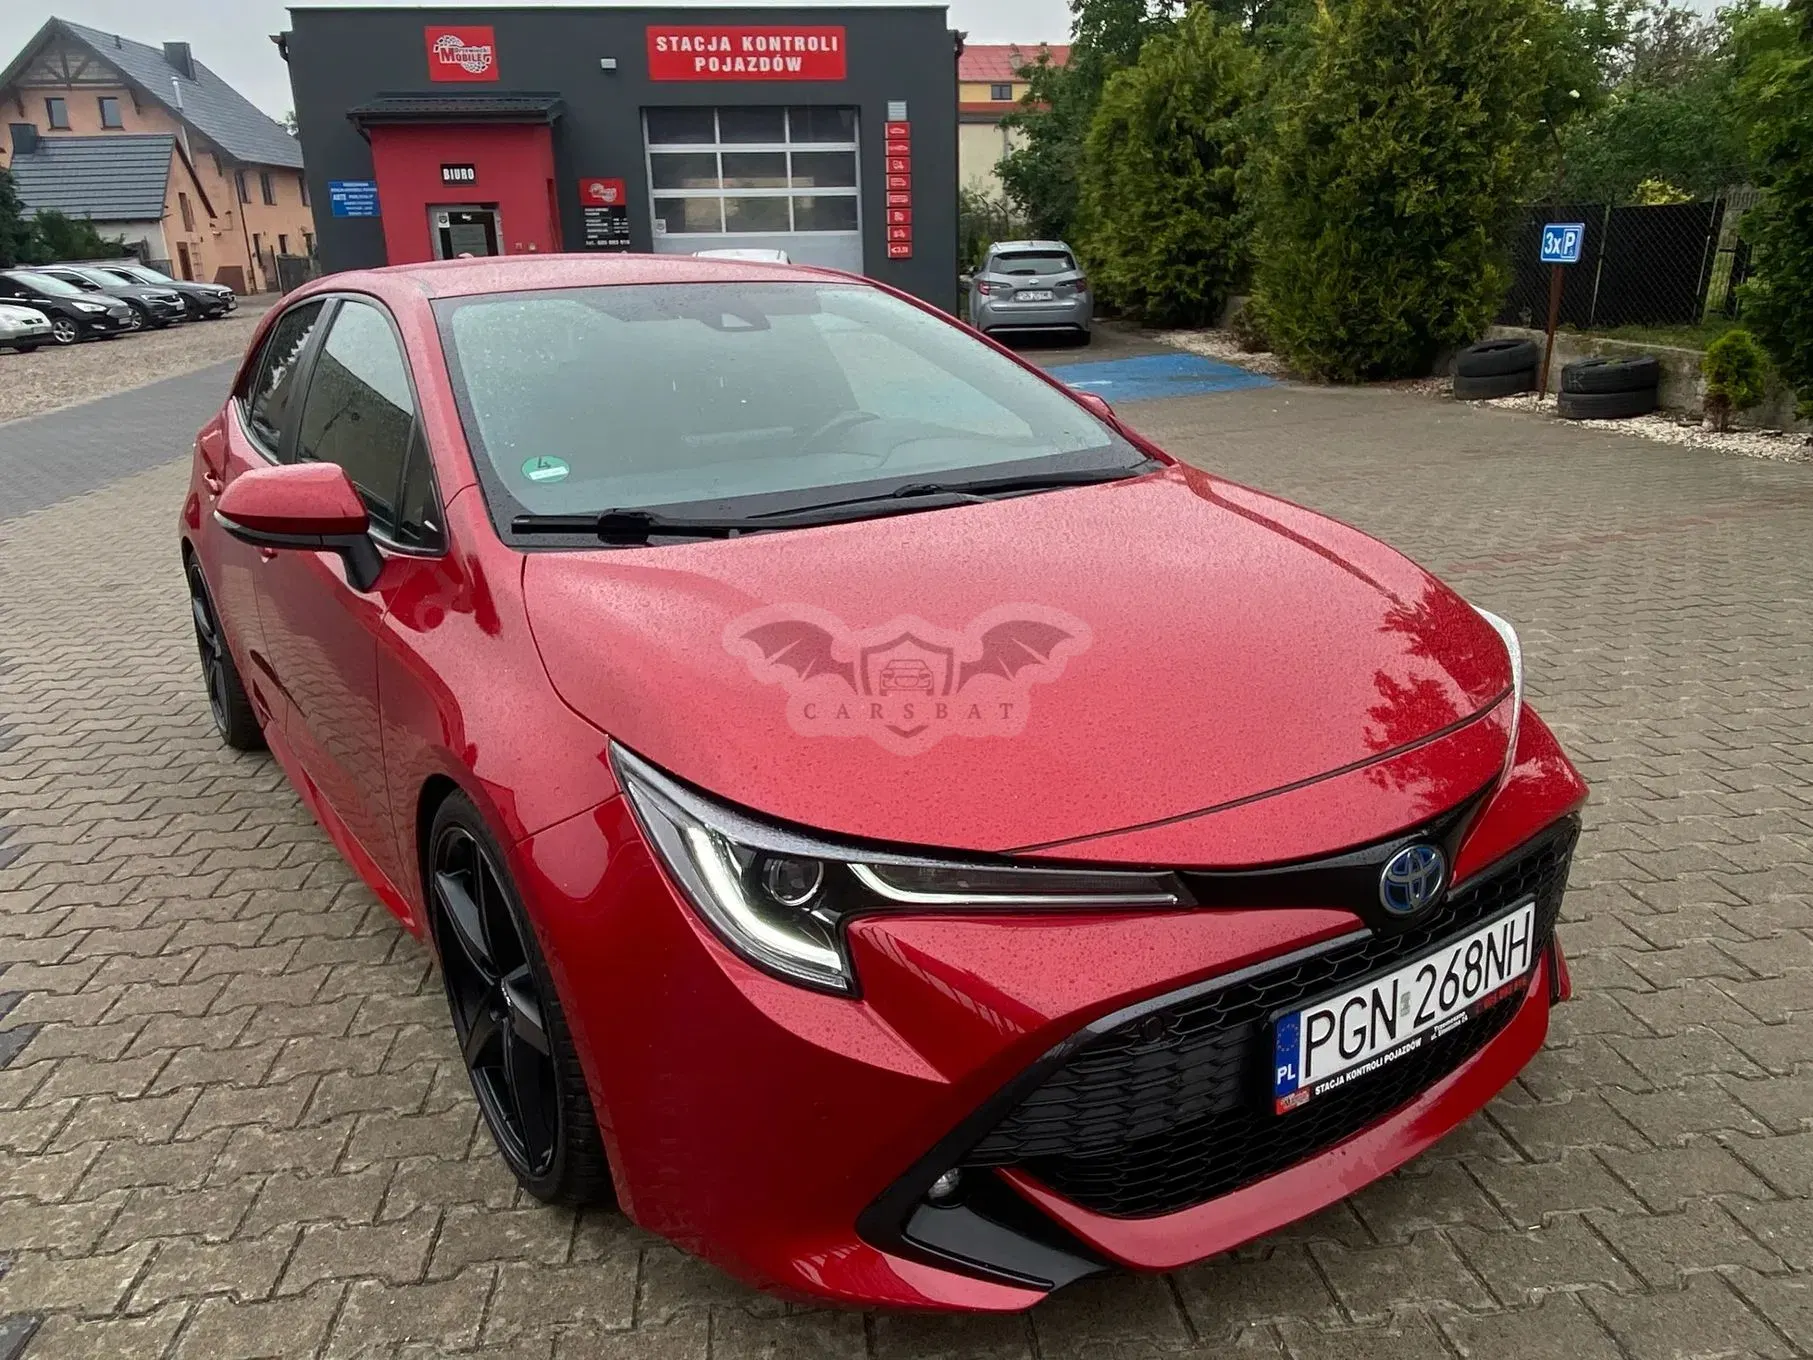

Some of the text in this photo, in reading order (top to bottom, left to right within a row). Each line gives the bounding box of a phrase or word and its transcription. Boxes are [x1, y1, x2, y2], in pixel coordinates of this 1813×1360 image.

[656, 36, 838, 52] STACJA KONTROLI
[694, 54, 802, 72] POJAZDÓW
[443, 168, 475, 180] BIURO
[1304, 910, 1531, 1080] PGN 268NH
[1277, 1063, 1296, 1085] PL
[1314, 1037, 1422, 1096] STACJA KONTROLI POJAZDÓW
